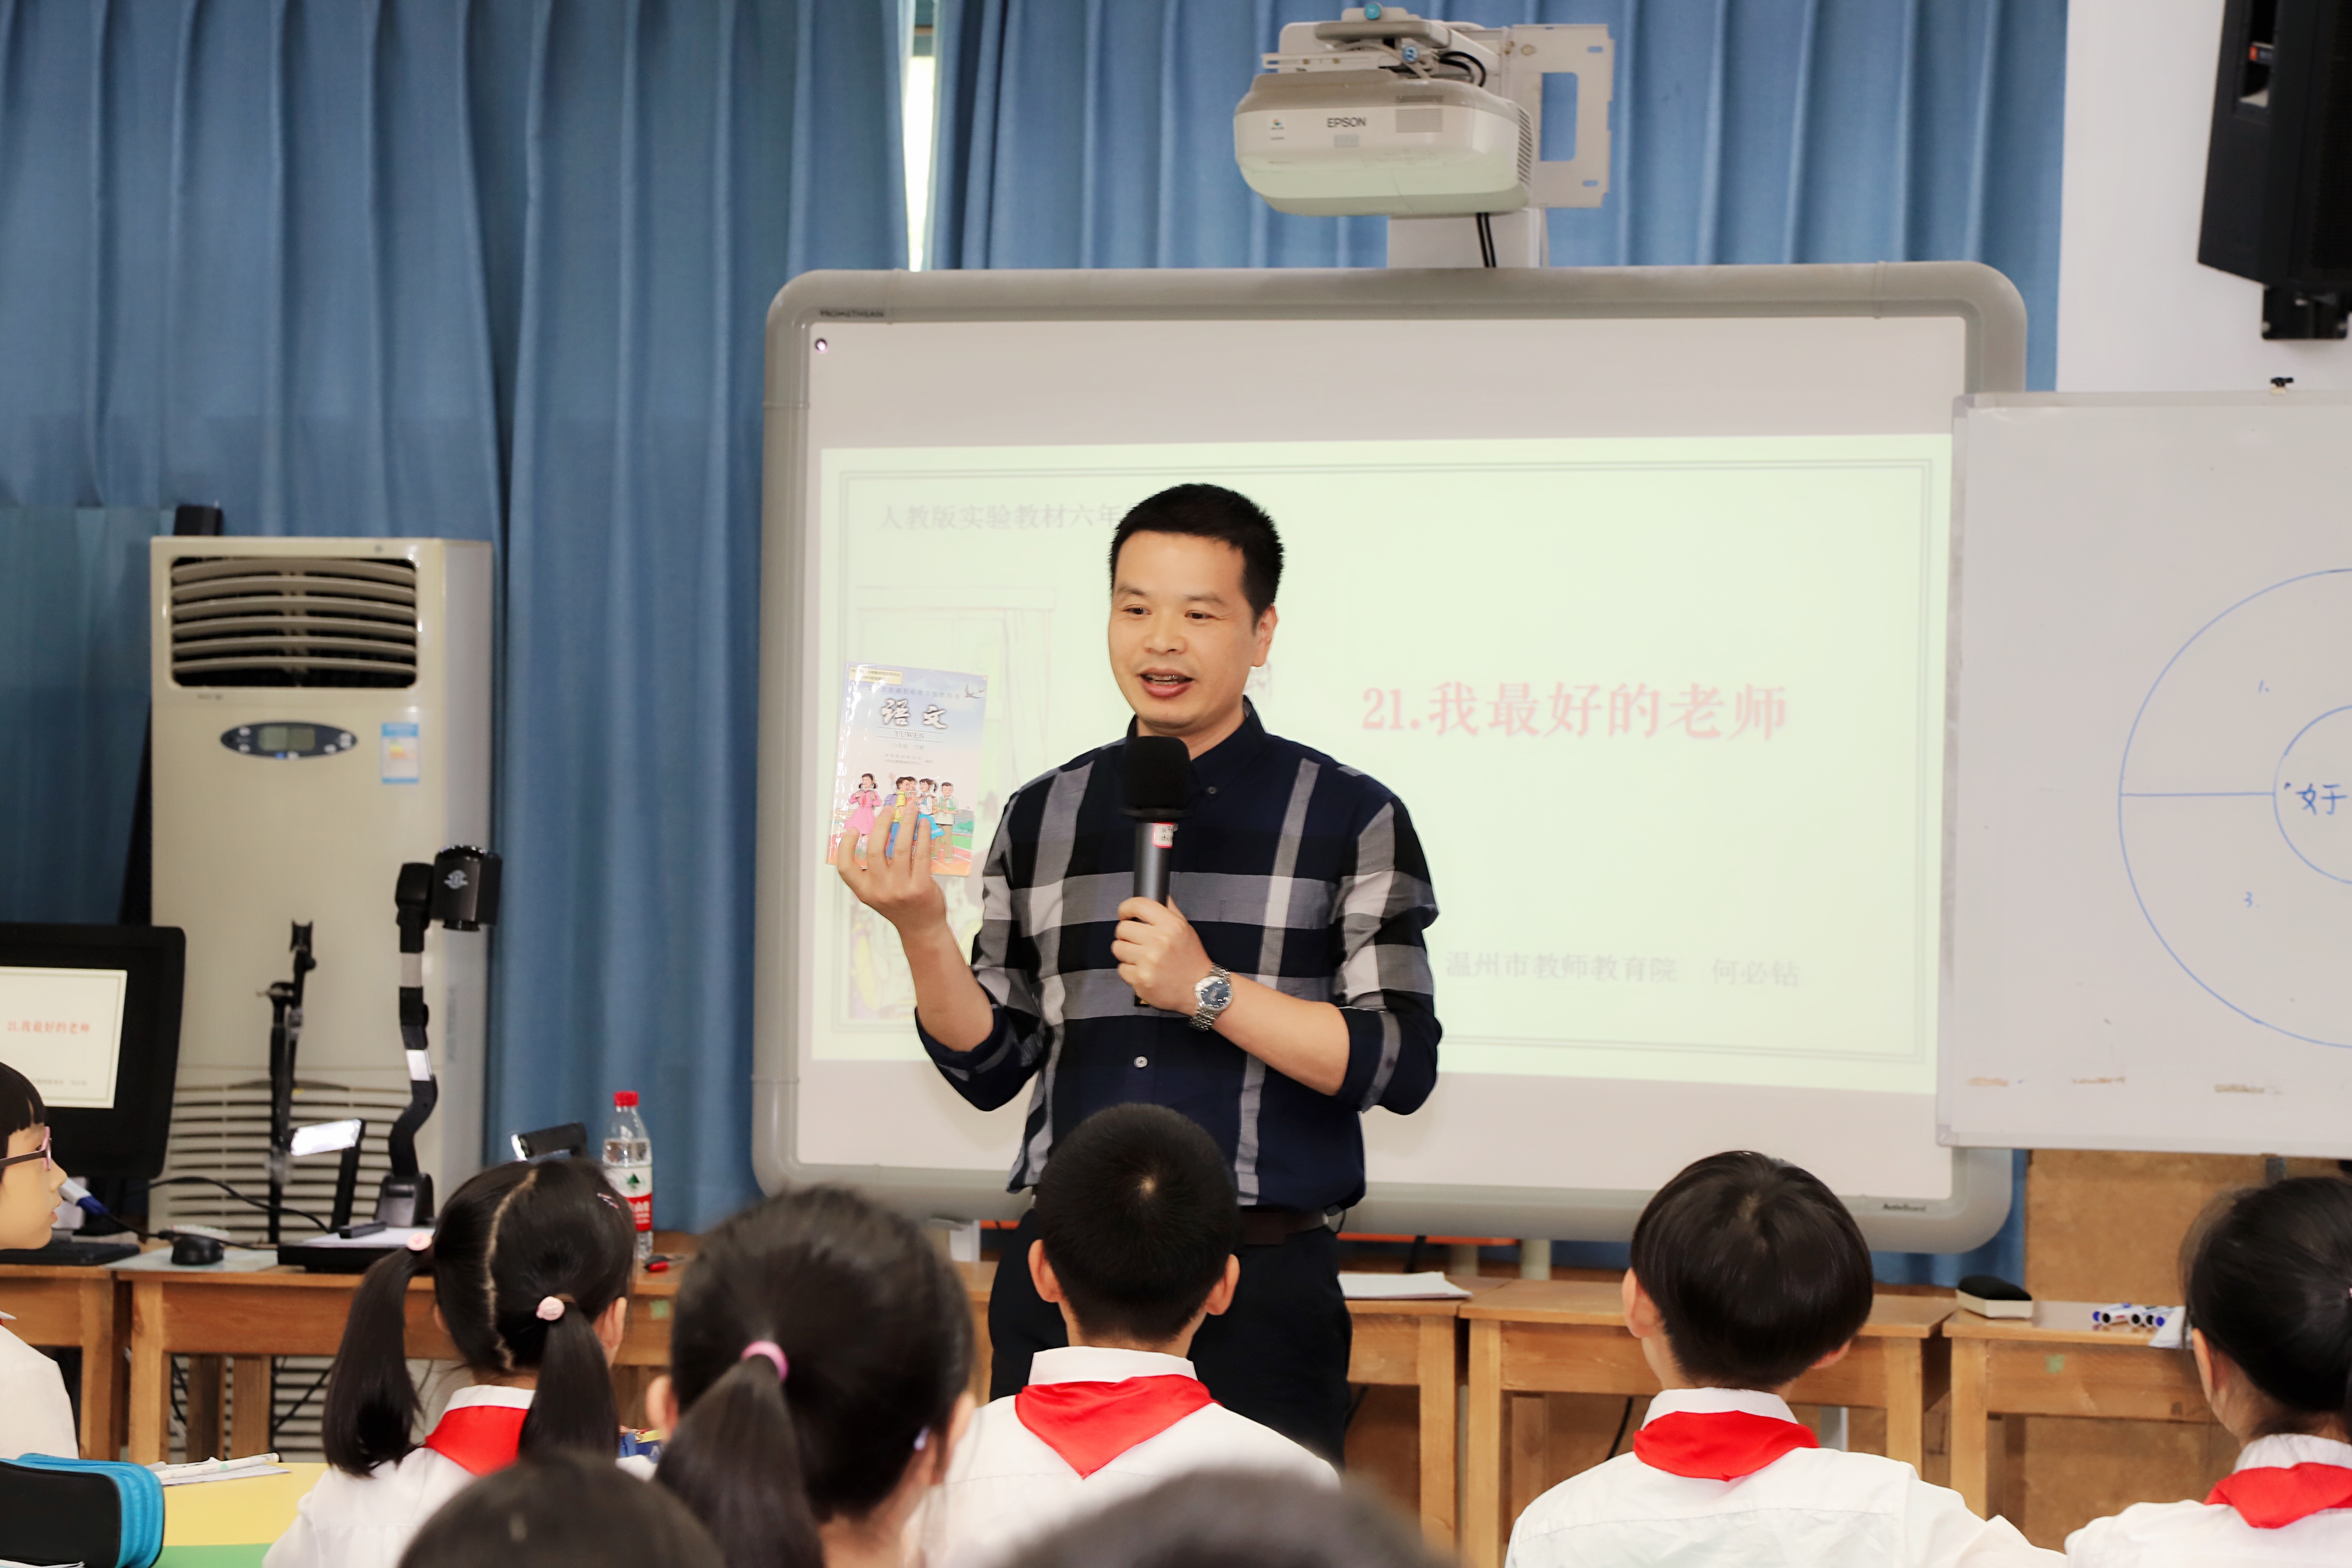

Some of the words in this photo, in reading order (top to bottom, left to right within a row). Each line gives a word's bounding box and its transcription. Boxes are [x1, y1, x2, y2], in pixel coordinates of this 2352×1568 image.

[1326, 117, 1366, 128] EPSON
[878, 502, 1134, 530] 人教版实验教材六年
[1362, 681, 1788, 741] 21.我最好的老师
[894, 730, 925, 740] YUWEN
[1445, 951, 1678, 984] 温州市教师教育院
